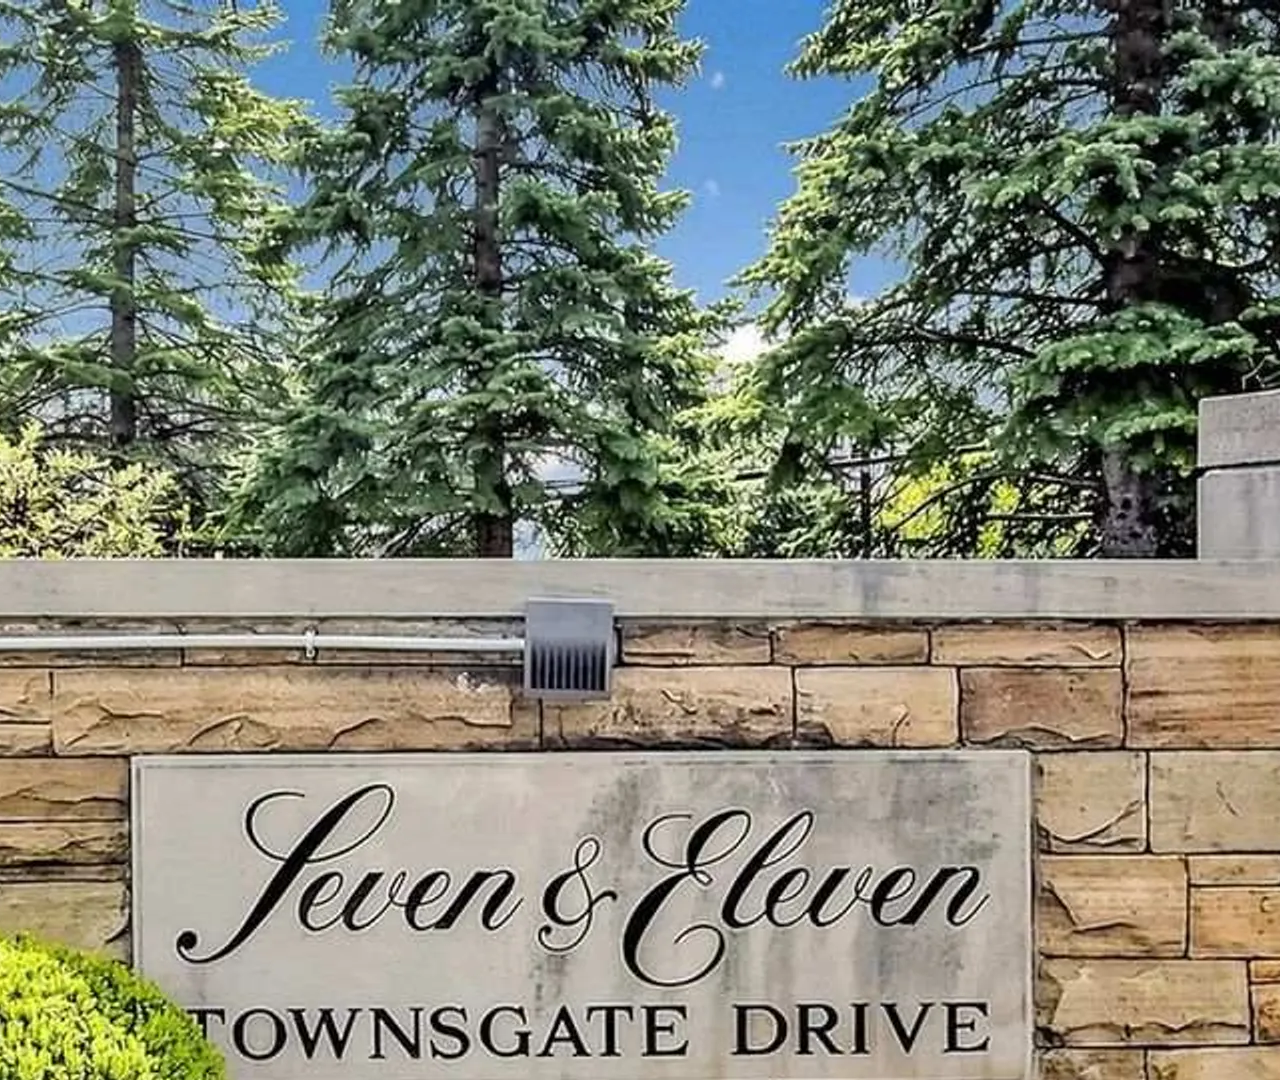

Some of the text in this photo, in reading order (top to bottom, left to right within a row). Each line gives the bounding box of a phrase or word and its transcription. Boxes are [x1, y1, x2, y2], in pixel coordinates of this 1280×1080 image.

[176, 783, 991, 987] Seven & Eleven
[185, 1002, 991, 1061] TOWNSGATE DRIVE
